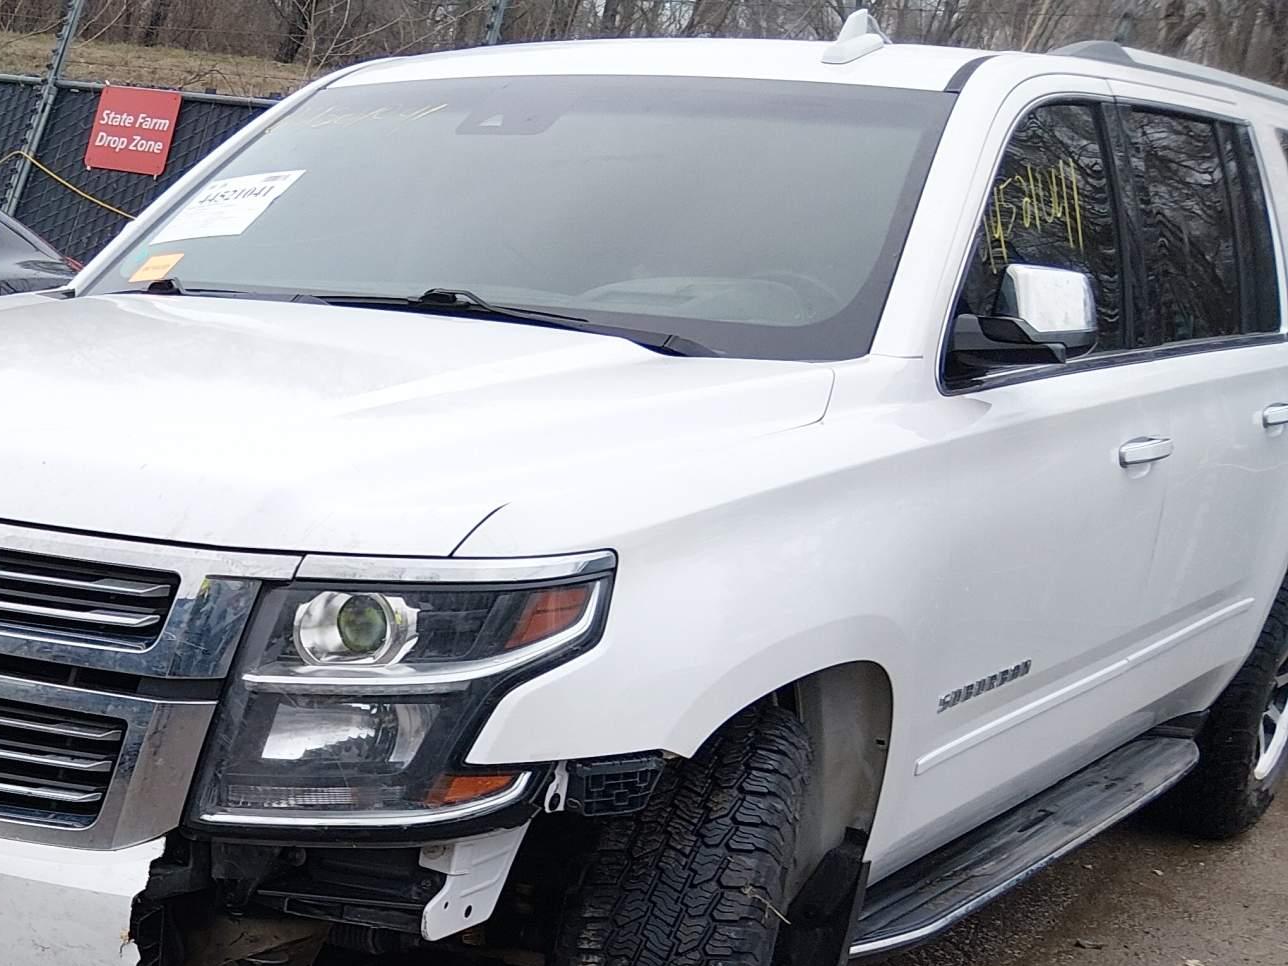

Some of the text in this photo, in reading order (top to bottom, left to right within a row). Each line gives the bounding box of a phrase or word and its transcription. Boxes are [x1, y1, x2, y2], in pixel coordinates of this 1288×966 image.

[100, 110, 170, 131] State Farm
[95, 132, 163, 154] Drop Zone
[936, 659, 1032, 714] SUBURBAN
